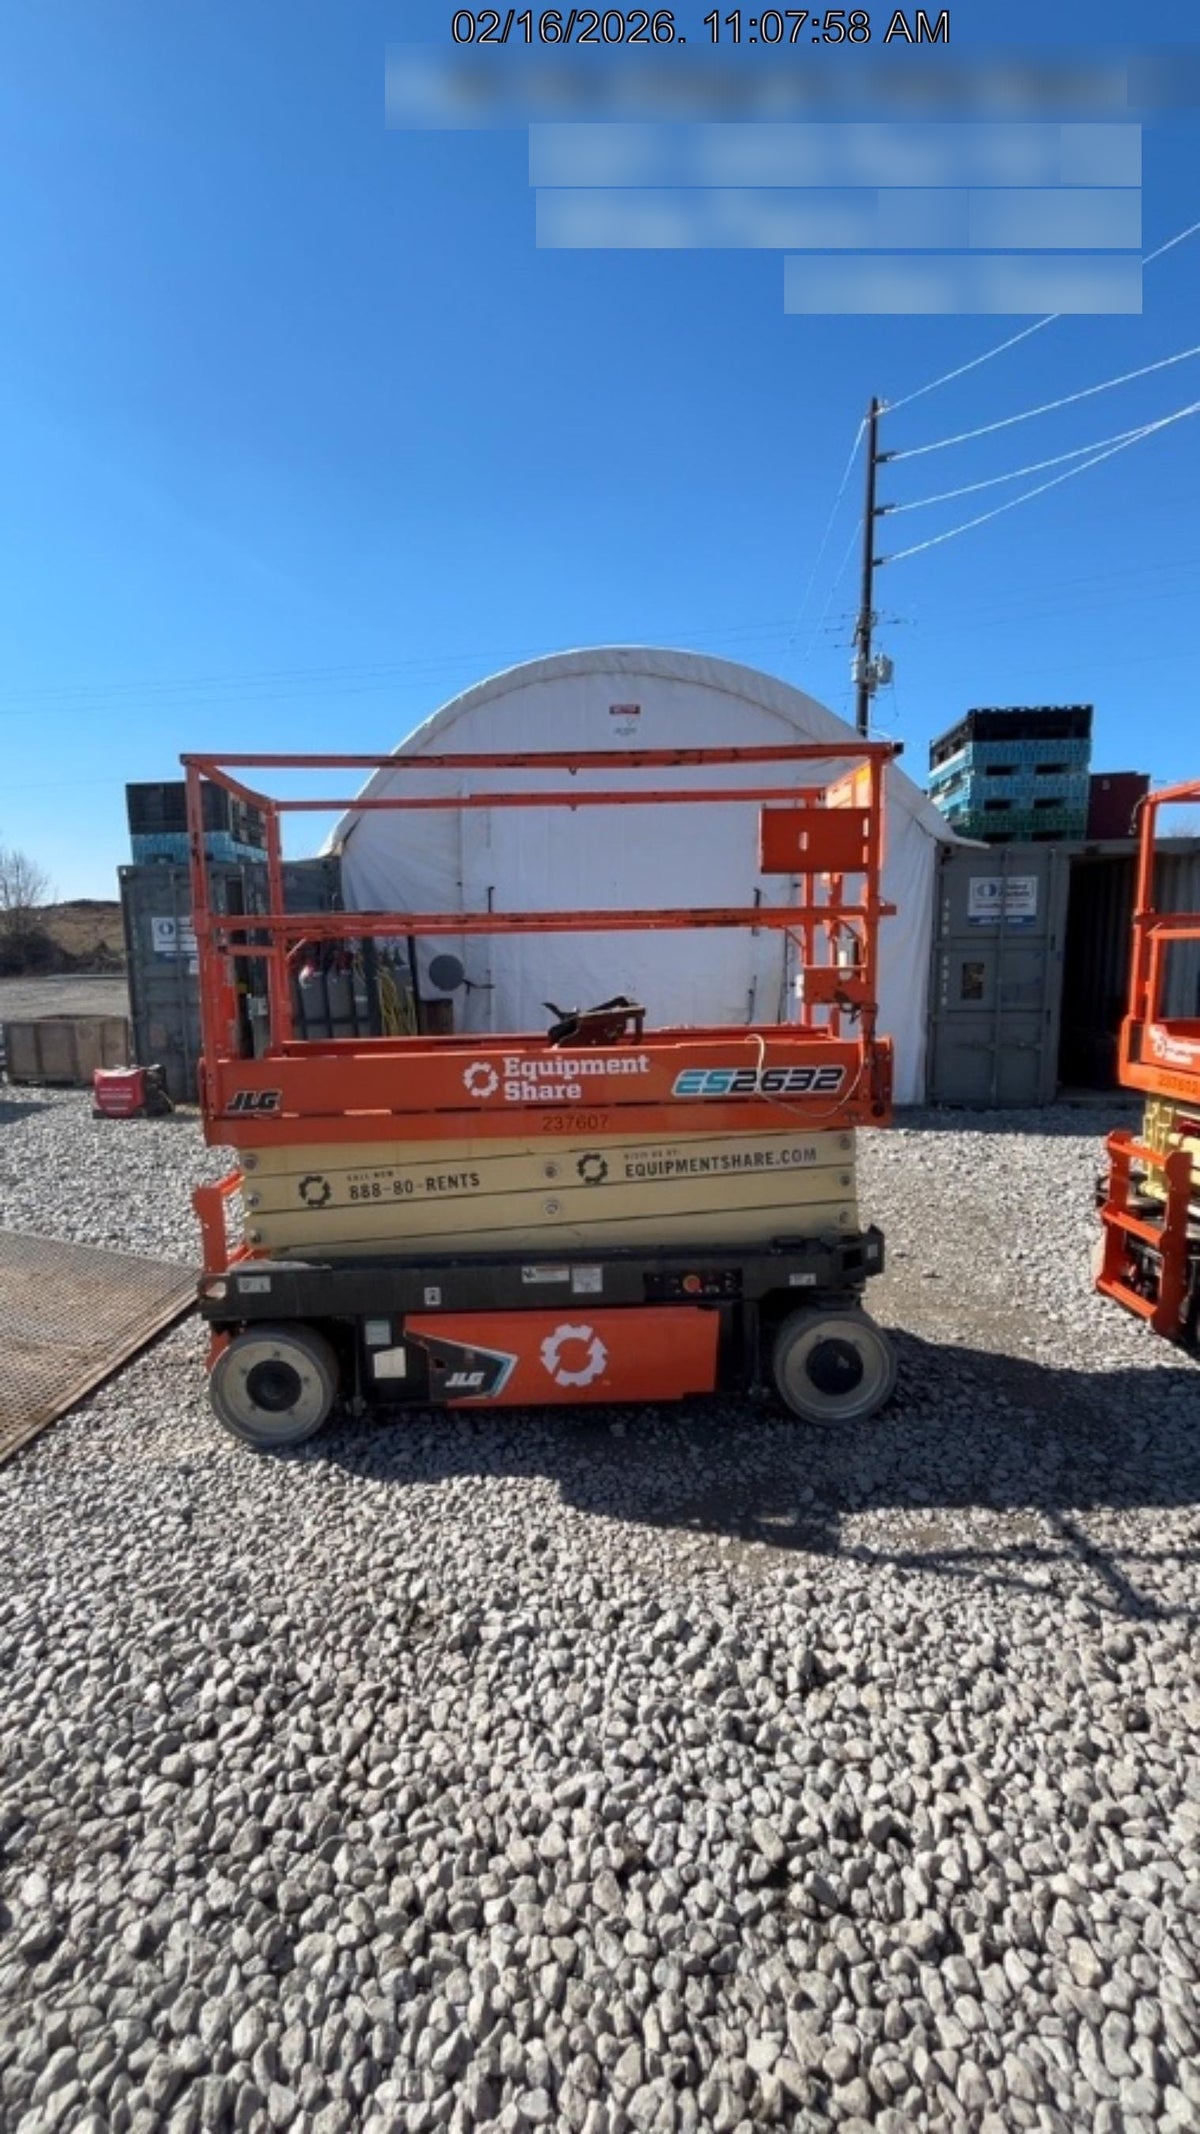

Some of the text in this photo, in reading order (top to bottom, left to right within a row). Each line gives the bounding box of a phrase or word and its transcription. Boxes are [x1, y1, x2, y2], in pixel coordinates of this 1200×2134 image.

[503, 1054, 650, 1082] Equipment
[505, 1081, 582, 1101] Share
[673, 1066, 845, 1097] ES2632
[226, 1089, 282, 1112] JLG
[541, 1113, 609, 1132] 237607
[624, 1147, 817, 1178] EQUIPMENTSHARE.COM
[348, 1172, 481, 1201] 888-80-RENTS
[445, 1371, 486, 1388] JLG
